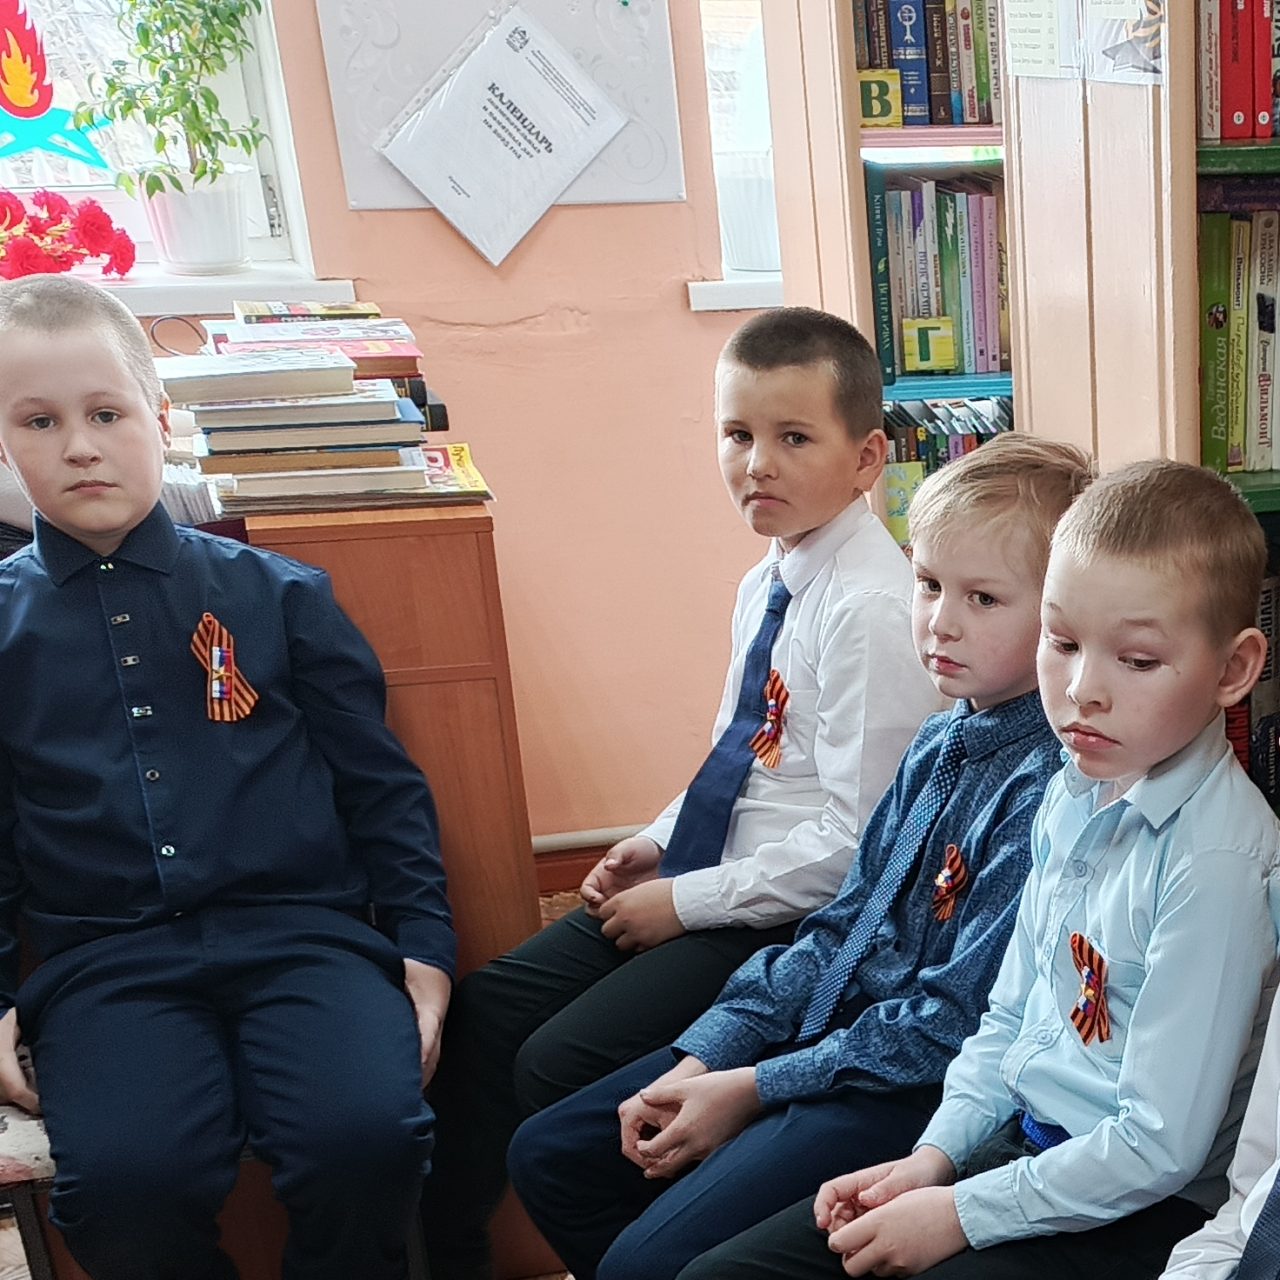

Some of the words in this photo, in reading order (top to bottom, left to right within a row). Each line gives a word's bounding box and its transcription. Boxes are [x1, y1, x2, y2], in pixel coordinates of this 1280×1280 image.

[933, 14, 941, 38] ВЕРН
[860, 80, 892, 118] В
[488, 83, 553, 154] КАЛЕНДАРЬ
[917, 326, 941, 363] Г
[1211, 337, 1227, 440] Веденская
